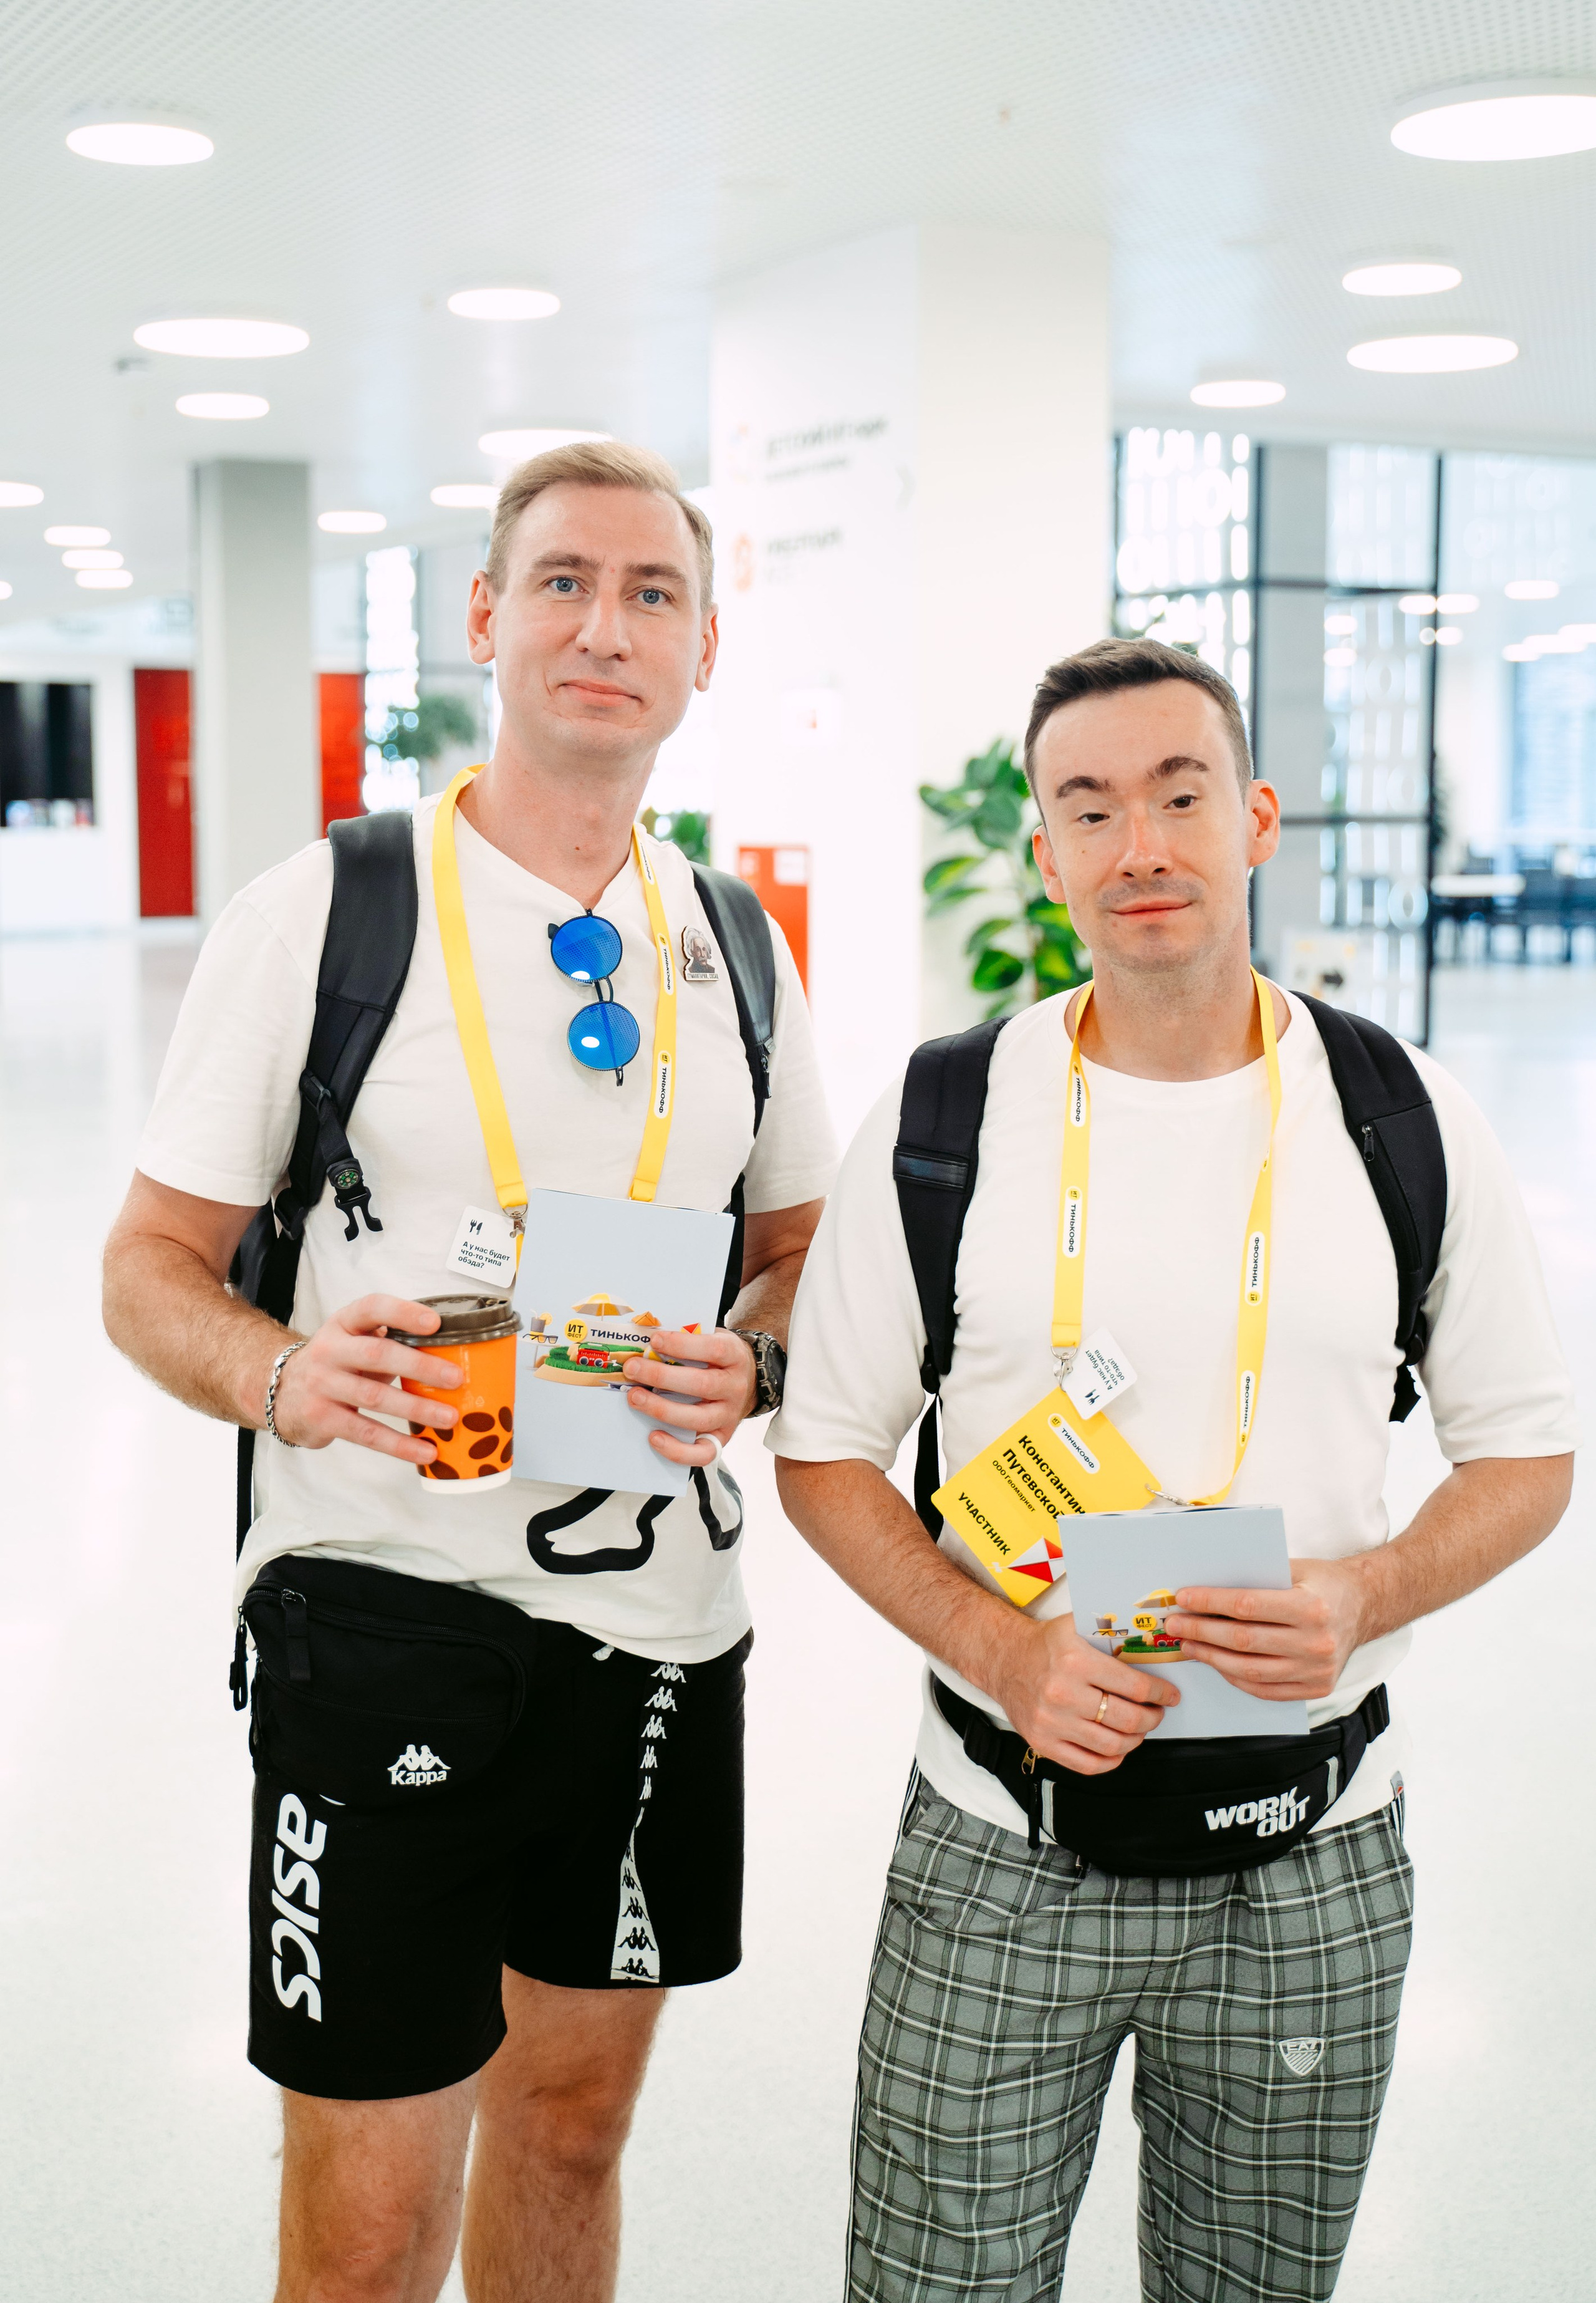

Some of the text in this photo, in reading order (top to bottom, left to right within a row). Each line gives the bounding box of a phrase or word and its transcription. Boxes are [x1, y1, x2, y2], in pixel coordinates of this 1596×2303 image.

[659, 1067, 667, 1114] ТИНЬКОФФ
[458, 1255, 484, 1268] обэда?
[461, 1248, 502, 1267] что-то типа
[474, 1245, 488, 1254] нас
[489, 1249, 511, 1261] будет
[568, 1323, 584, 1333] ИТ
[590, 1329, 651, 1343] ТИНЬКОФ
[1085, 1349, 1099, 1369] будет
[1094, 1349, 1118, 1386] что-то типа
[1107, 1358, 1125, 1381] обэда?
[1097, 1368, 1107, 1380] нас
[1062, 1427, 1095, 1468] ТИНЬКОФФ
[993, 1460, 1036, 1512] ООО Геомаркет
[958, 1491, 1011, 1556] УЧАСТНИК
[391, 1770, 447, 1786] Kappa
[1204, 1786, 1297, 1830] WORK
[1256, 1795, 1310, 1837] OUT
[272, 1794, 327, 2022] asics
[1287, 2040, 1317, 2050] EA7
